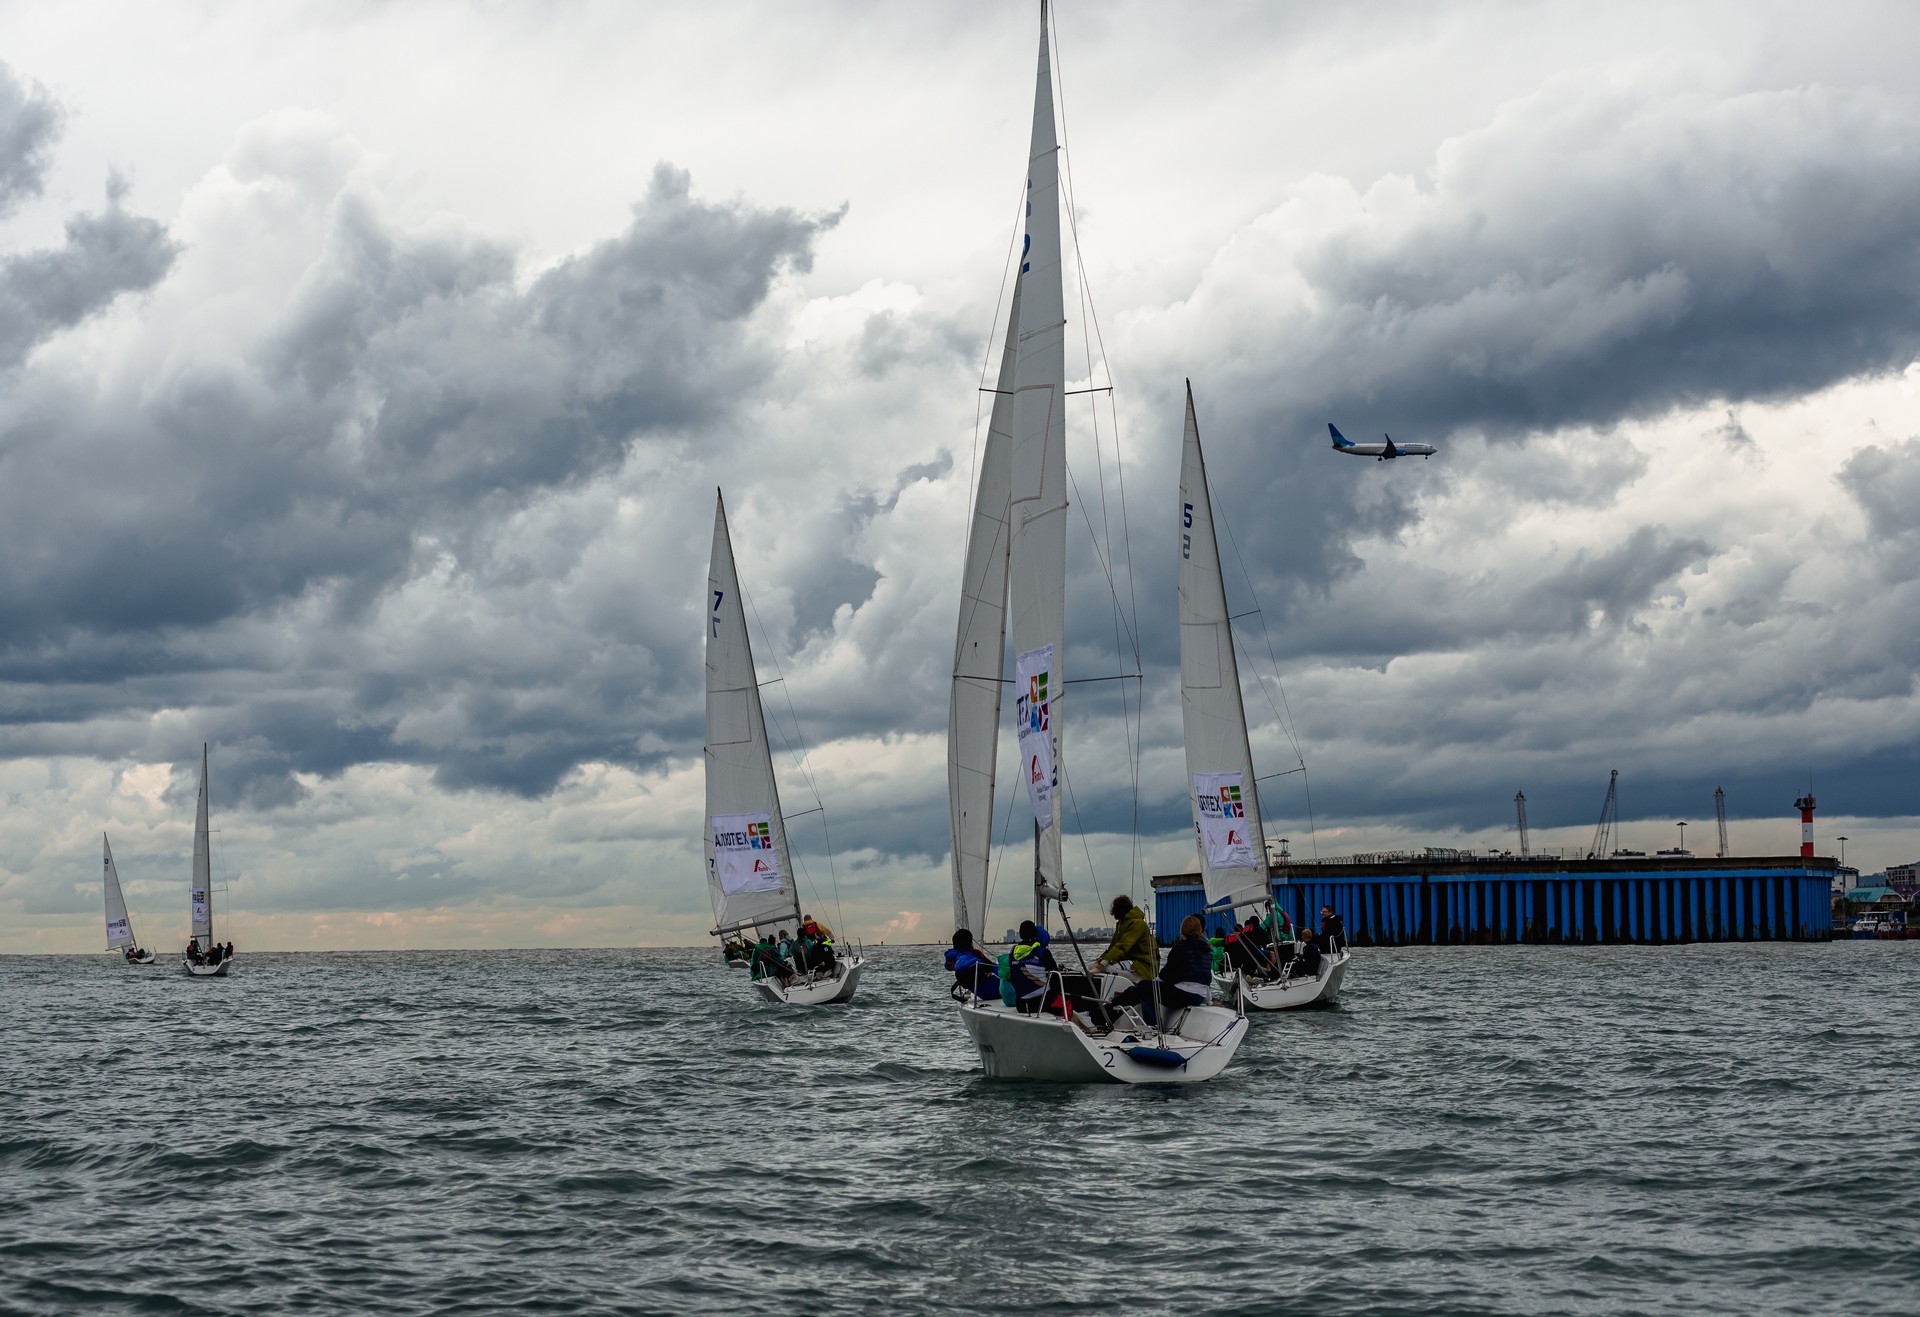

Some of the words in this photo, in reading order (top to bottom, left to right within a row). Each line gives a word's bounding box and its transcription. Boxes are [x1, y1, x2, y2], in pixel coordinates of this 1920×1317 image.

[1183, 502, 1194, 529] 5
[714, 590, 723, 611] 7
[1251, 992, 1259, 1002] 5
[1103, 1051, 1116, 1068] 2
